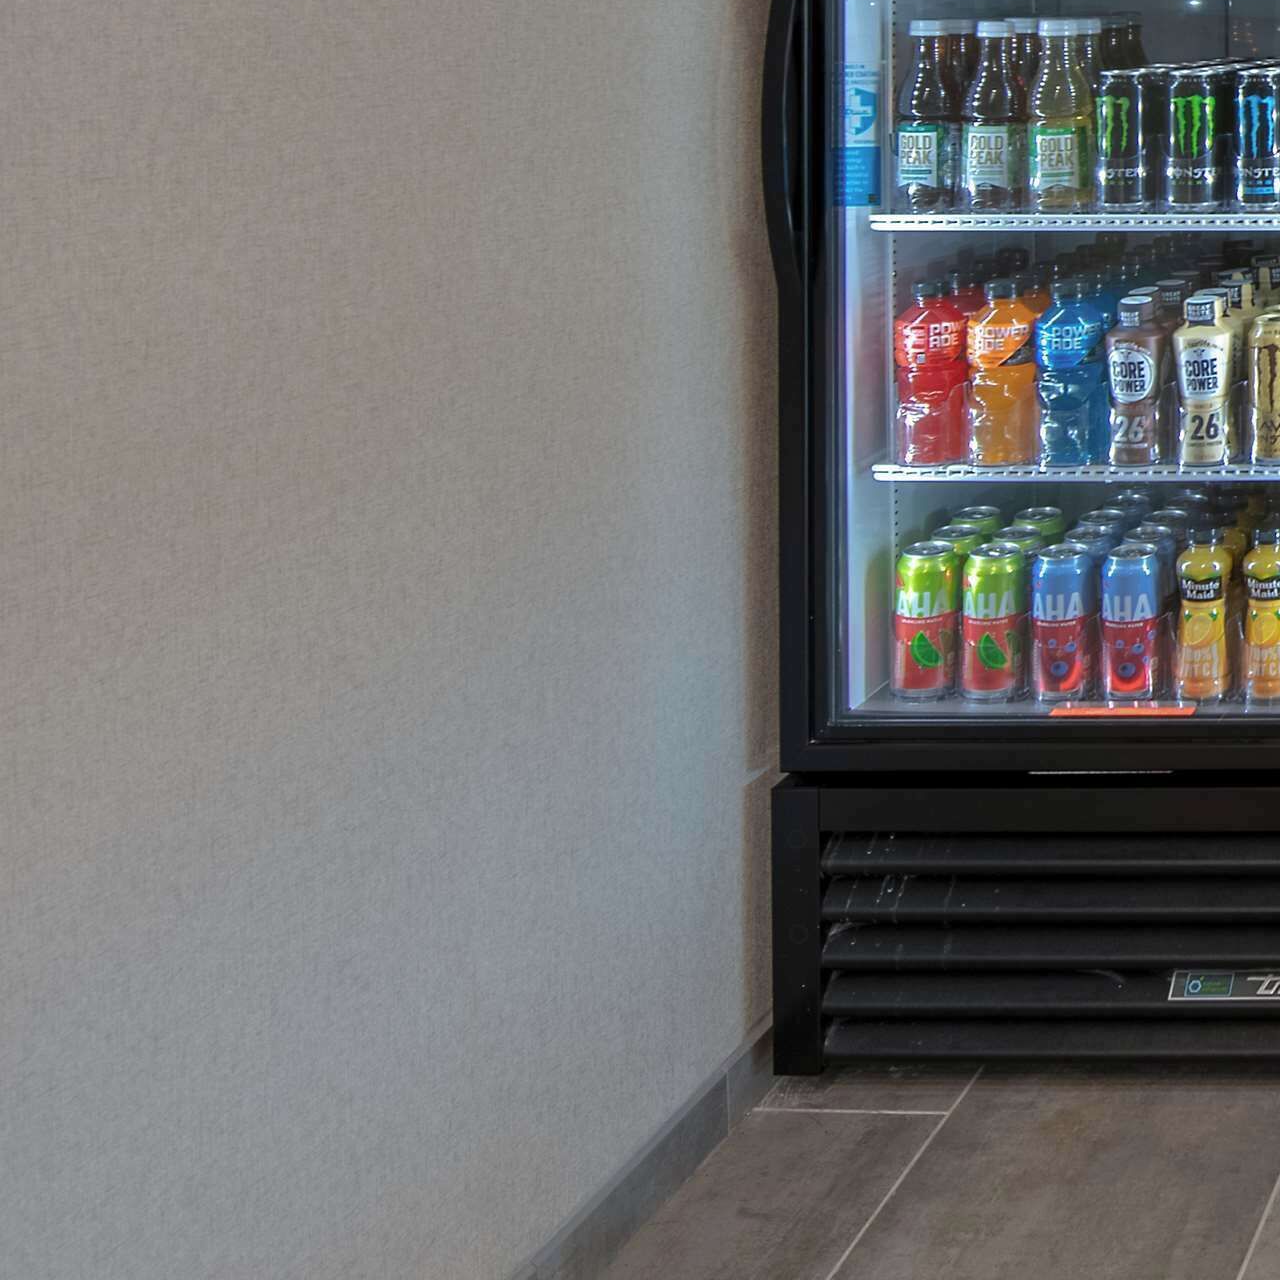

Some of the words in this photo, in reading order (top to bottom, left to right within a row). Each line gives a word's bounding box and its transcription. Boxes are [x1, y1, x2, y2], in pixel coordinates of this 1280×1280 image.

[900, 134, 932, 150] GOLD
[970, 135, 1003, 150] GOLD
[1040, 137, 1073, 152] GOLD
[900, 150, 932, 165] PEAK
[970, 150, 1003, 165] PEAK
[1040, 152, 1074, 167] PEAK
[1112, 361, 1145, 379] CORE
[1184, 358, 1218, 377] CORE
[1113, 379, 1146, 393] POWER
[1185, 377, 1218, 391] POWER
[1182, 578, 1220, 590] Minute
[1186, 588, 1214, 599] Maid
[1251, 588, 1279, 599] Maid
[897, 591, 948, 617] AHA
[964, 590, 1016, 617] AHA
[1033, 592, 1083, 620] AHA
[1103, 593, 1151, 620] AHA
